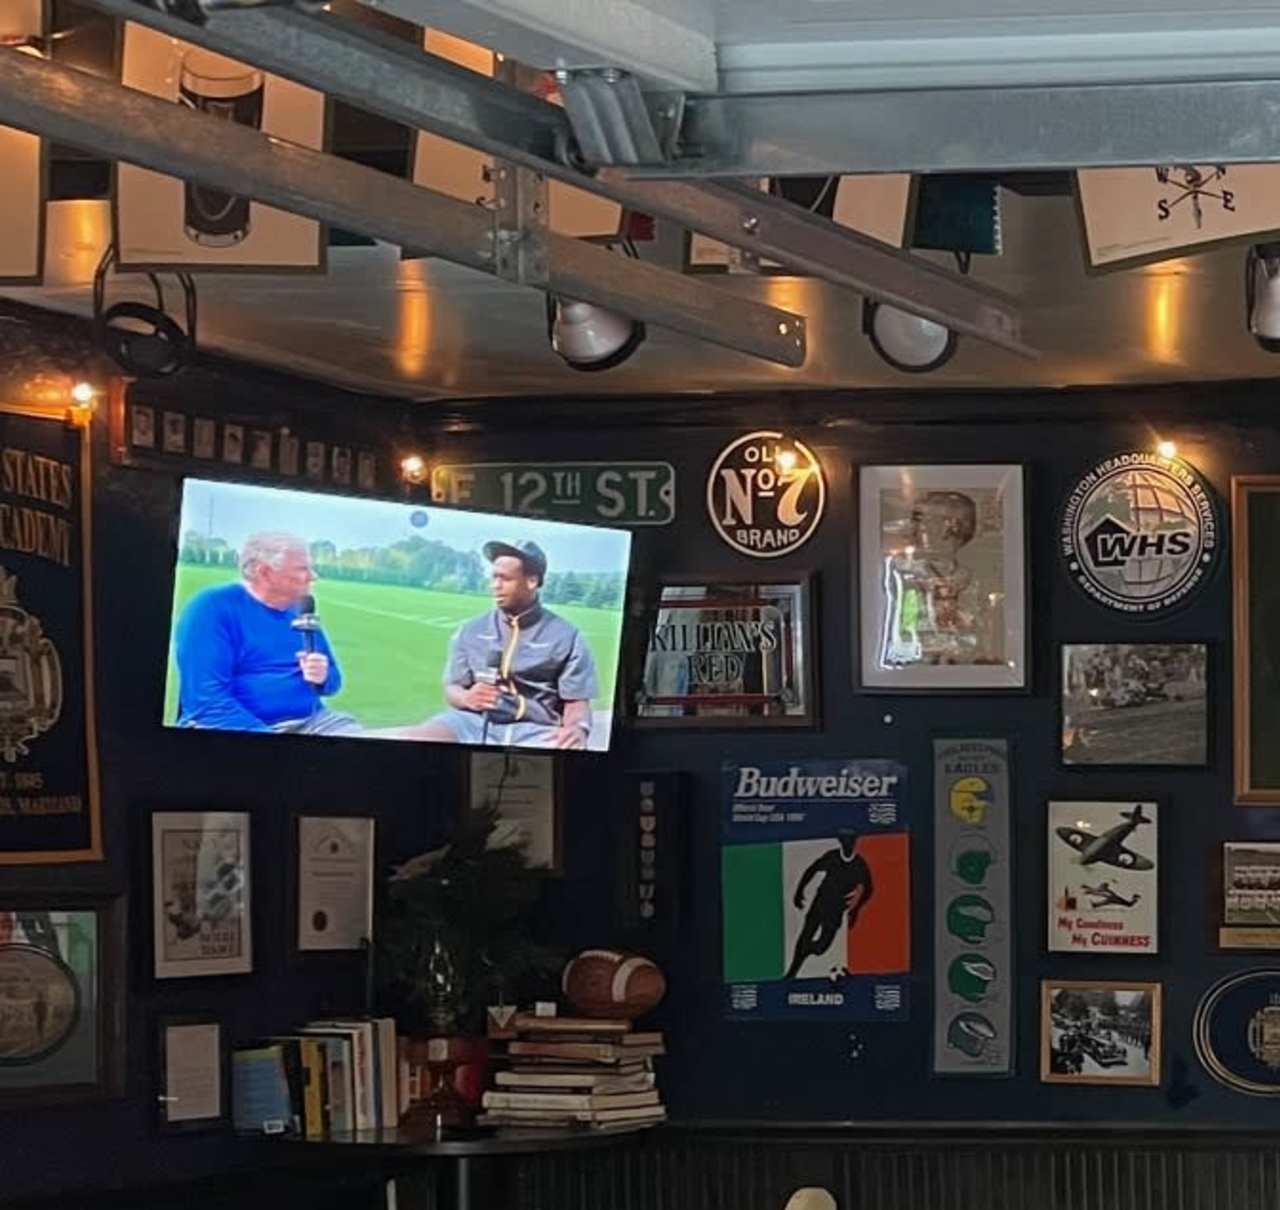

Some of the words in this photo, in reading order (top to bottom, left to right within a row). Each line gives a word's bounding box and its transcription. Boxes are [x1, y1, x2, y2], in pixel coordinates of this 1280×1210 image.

[2, 448, 73, 510] STATES
[596, 469, 657, 518] ST.
[1060, 472, 1099, 558] WASHINGTON
[1190, 481, 1216, 549] SERVICES
[735, 528, 800, 549] BRAND
[1098, 530, 1192, 561] WHS
[649, 620, 778, 653] KILLIAN'S
[687, 652, 746, 685] RED
[733, 766, 899, 798] Budweiser
[1057, 917, 1073, 931] My
[1071, 934, 1088, 946] My
[787, 992, 845, 1006] IRELAND
